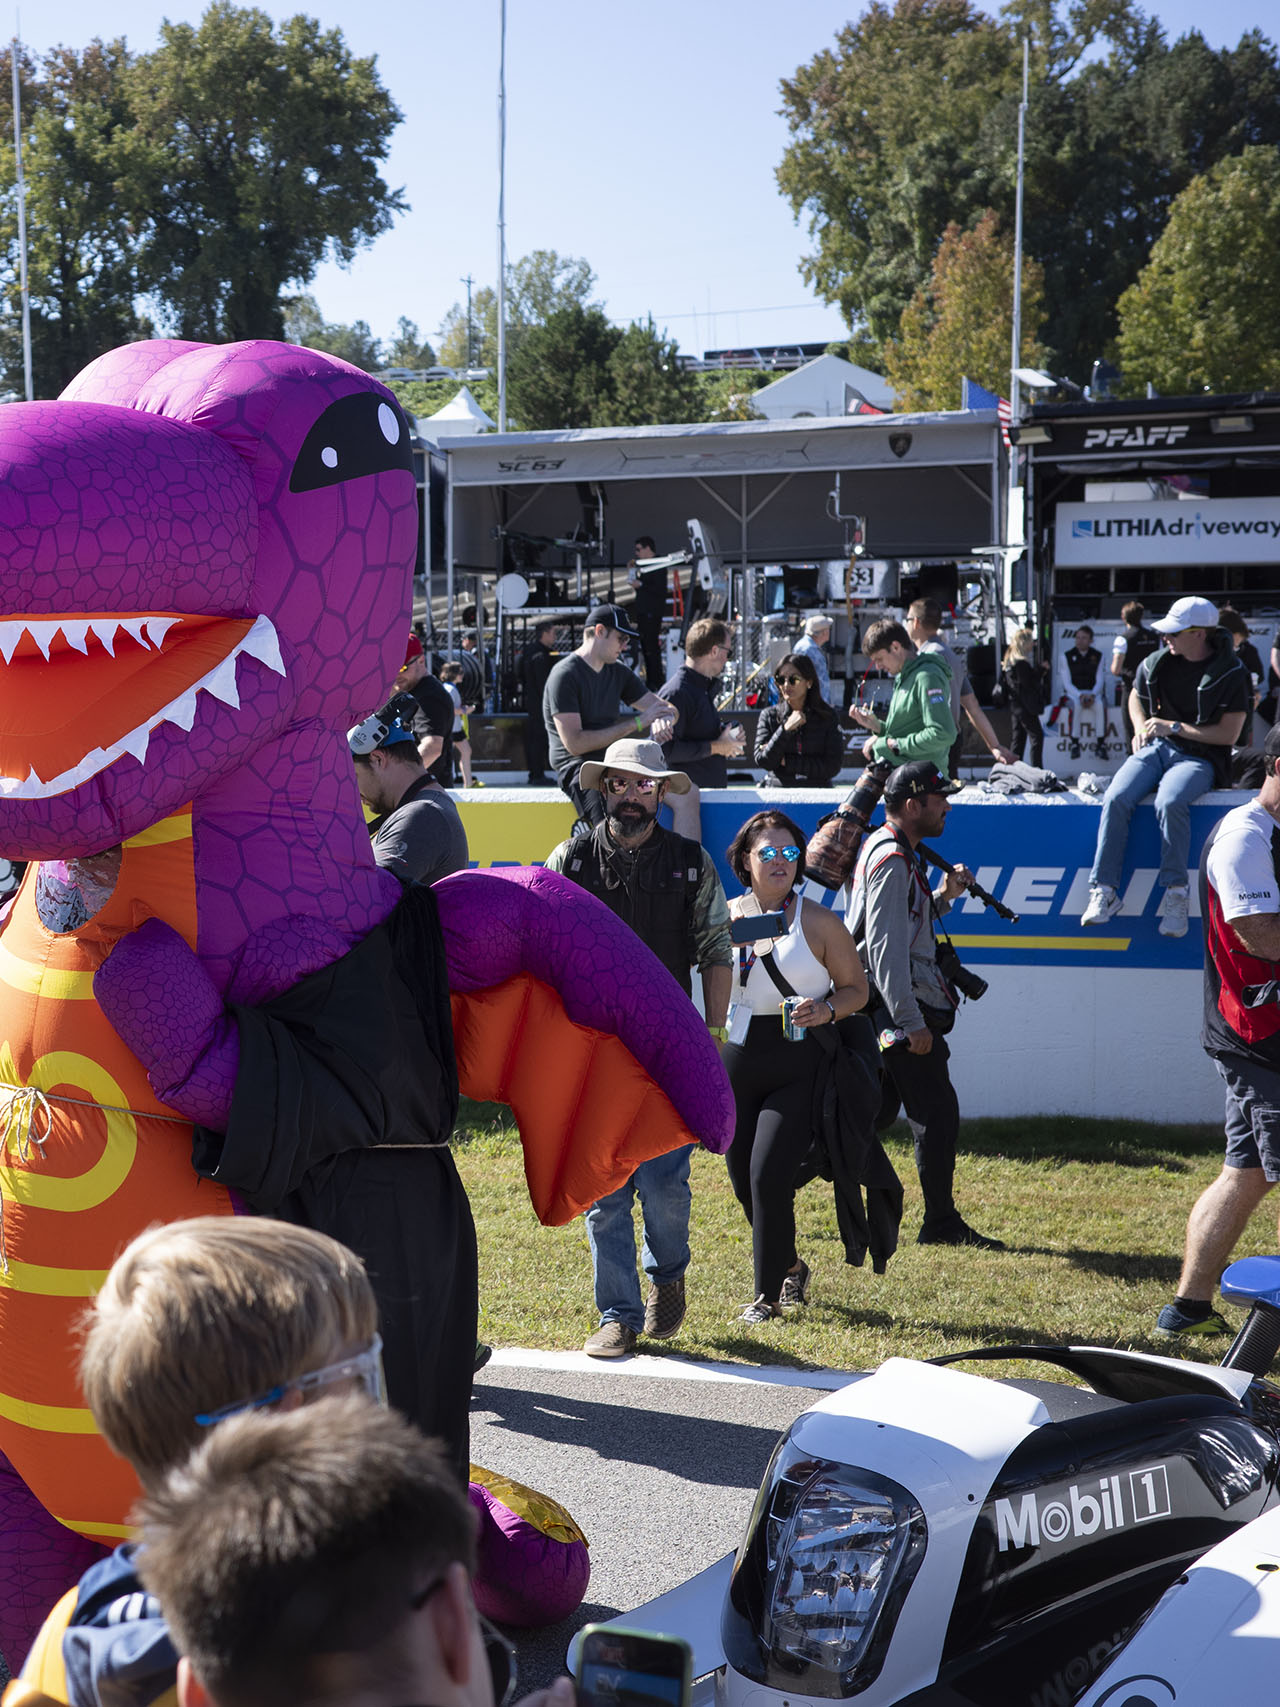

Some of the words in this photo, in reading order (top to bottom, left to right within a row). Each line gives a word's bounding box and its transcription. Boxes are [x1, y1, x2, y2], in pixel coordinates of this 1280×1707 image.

[1084, 426, 1190, 448] PFAFF
[1238, 891, 1262, 901] Mobil
[995, 1474, 1125, 1552] Mobil
